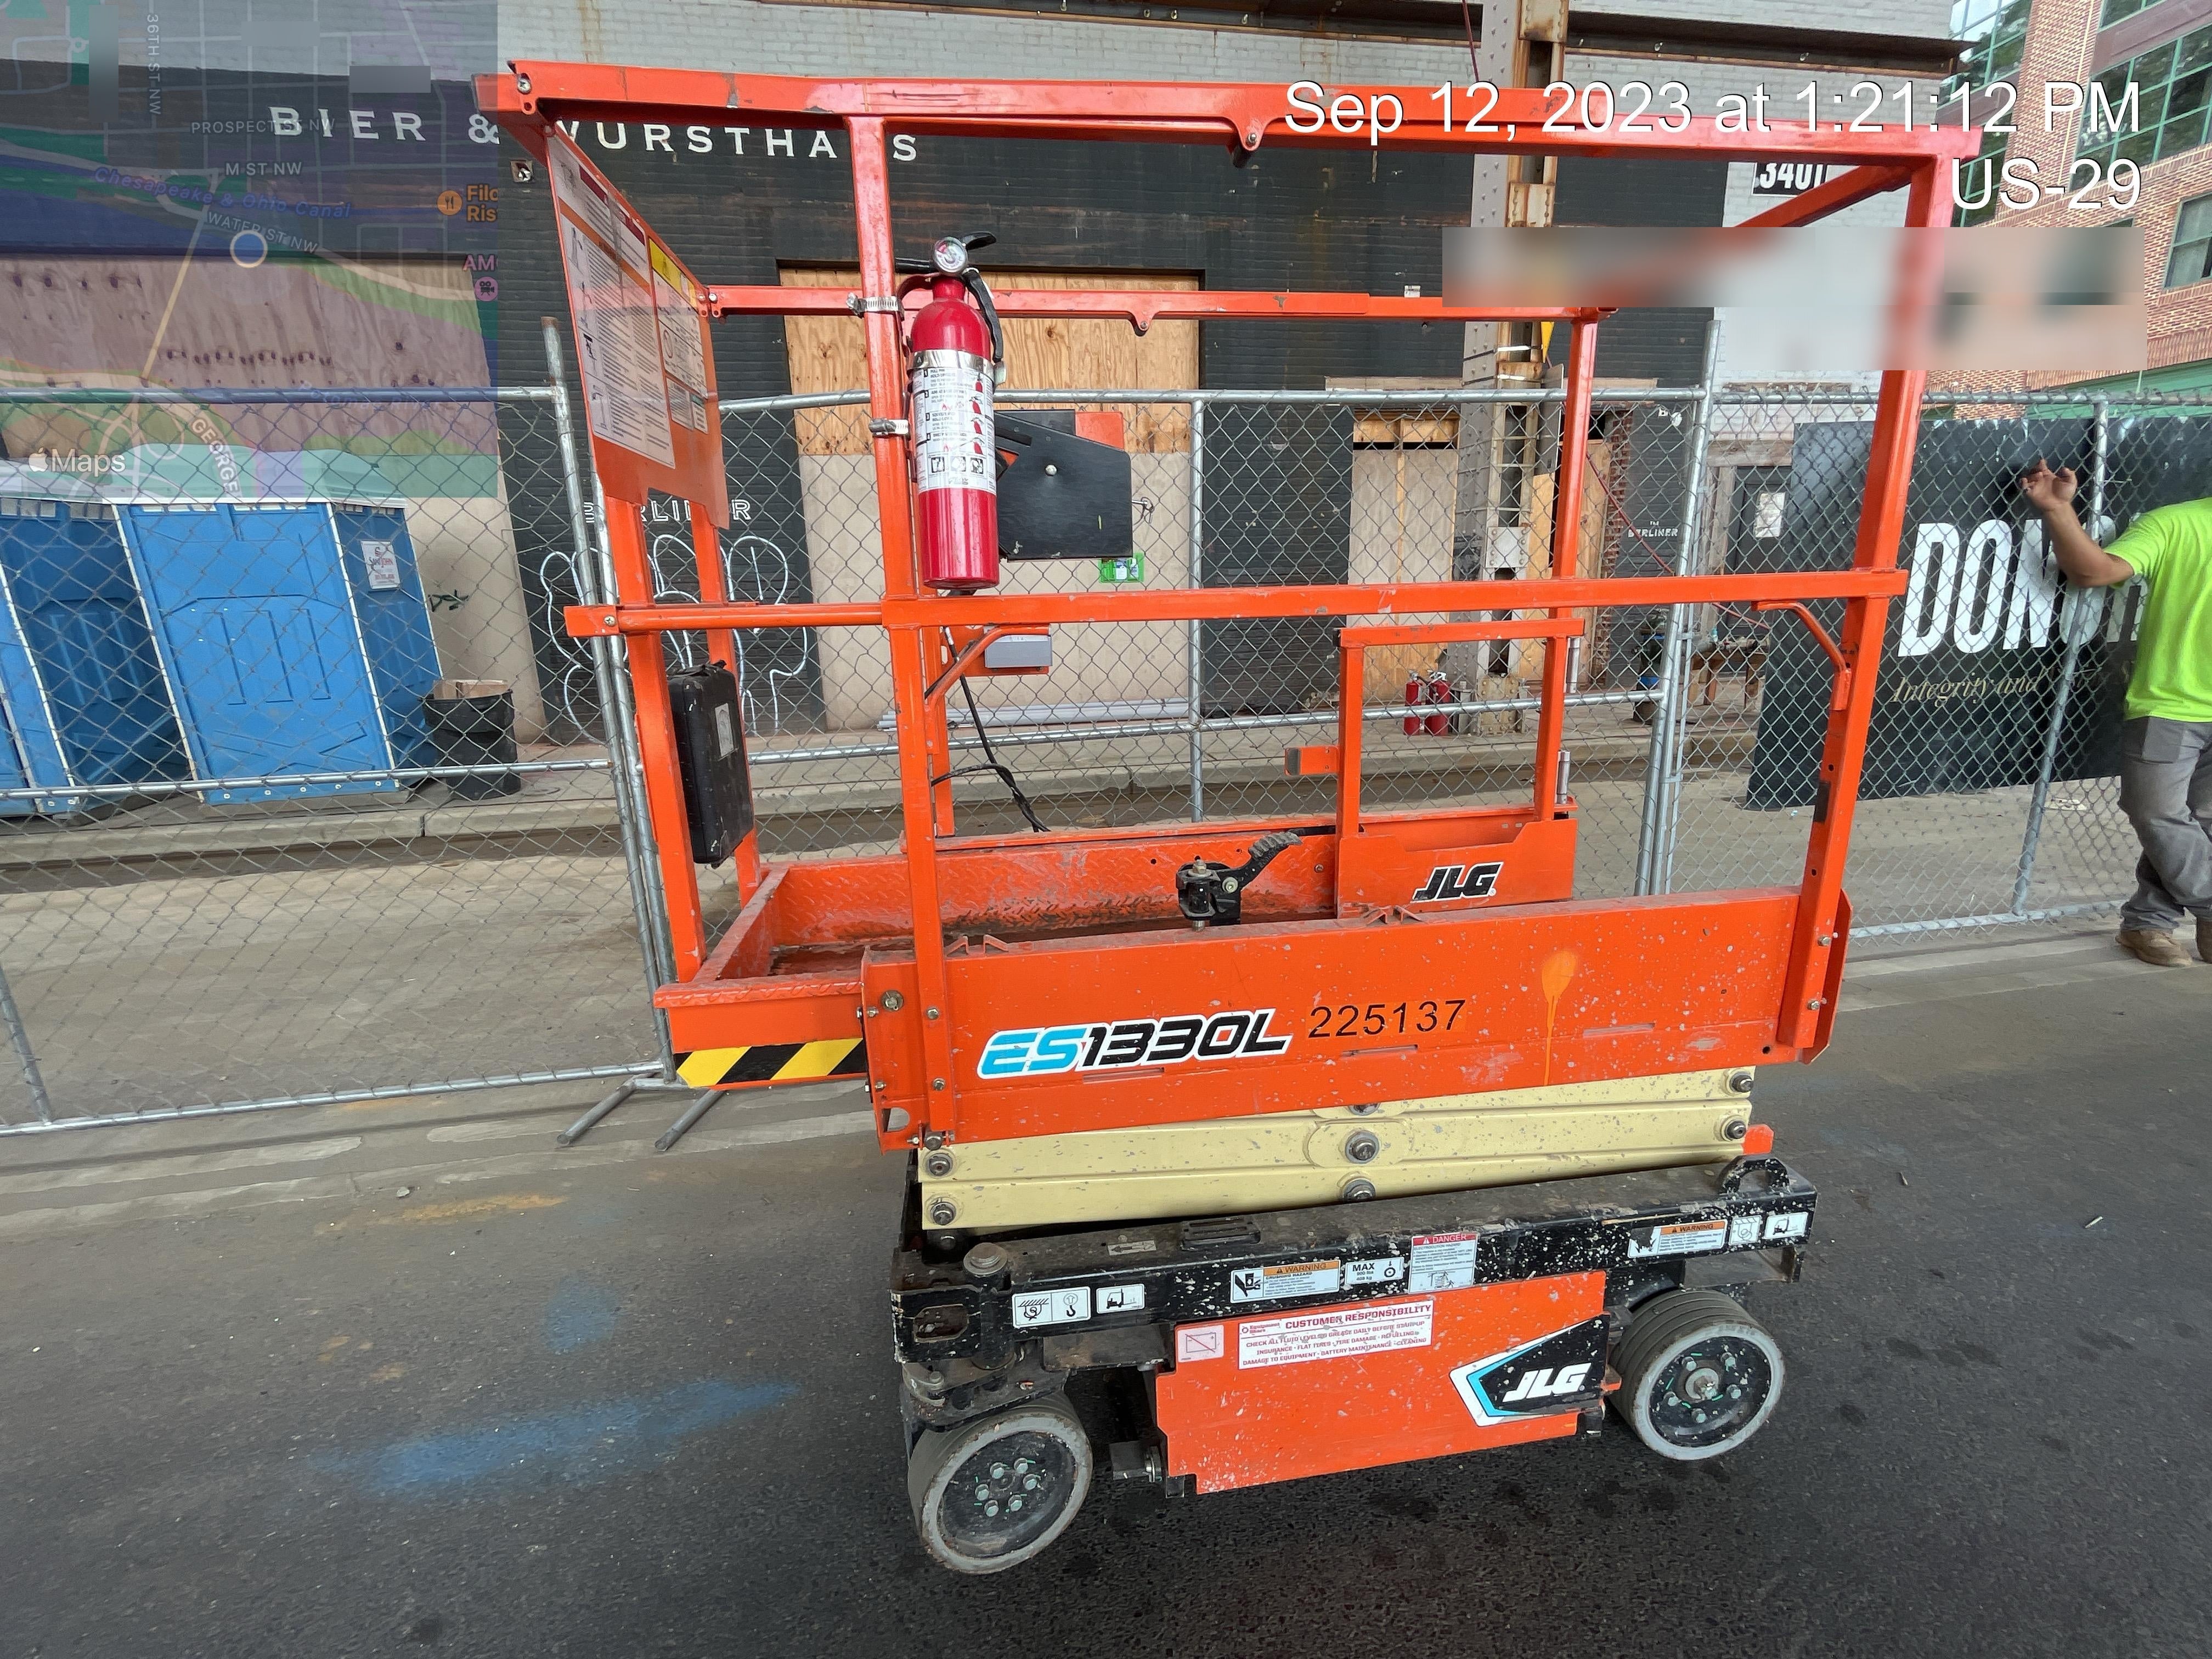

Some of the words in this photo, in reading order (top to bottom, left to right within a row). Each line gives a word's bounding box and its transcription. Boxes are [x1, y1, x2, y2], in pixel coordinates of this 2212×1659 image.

[268, 106, 426, 141] BIER
[556, 120, 917, 162] URSTHAS
[1759, 162, 1824, 190] 3401
[1891, 672, 1988, 708] Integrity
[1997, 667, 2045, 694] and
[1412, 862, 1503, 902] JLG
[981, 1010, 1291, 1075] ES1330L
[1307, 998, 1468, 1039] 225137
[1432, 1234, 1467, 1244] DANGER
[1679, 1223, 1714, 1232] WARNING
[1285, 1262, 1327, 1273] WARNING
[1352, 1263, 1375, 1272] MAX
[1285, 1316, 1342, 1329] CUSTOMER
[1345, 1305, 1431, 1322] RESPONSIBILITY
[1256, 1346, 1293, 1355] INSURANCE
[1351, 1335, 1376, 1343] DAMAGE
[1381, 1330, 1415, 1339] REFUELING
[1329, 1329, 1352, 1338] GREASE
[1243, 1357, 1269, 1365] DAMAGE
[1280, 1352, 1317, 1361] EQUIPMENT
[1321, 1347, 1347, 1356] BATTERY
[1348, 1340, 1392, 1352] MAINTENANCE
[1398, 1337, 1427, 1346] CLEANING
[1502, 1362, 1592, 1403] JLG
